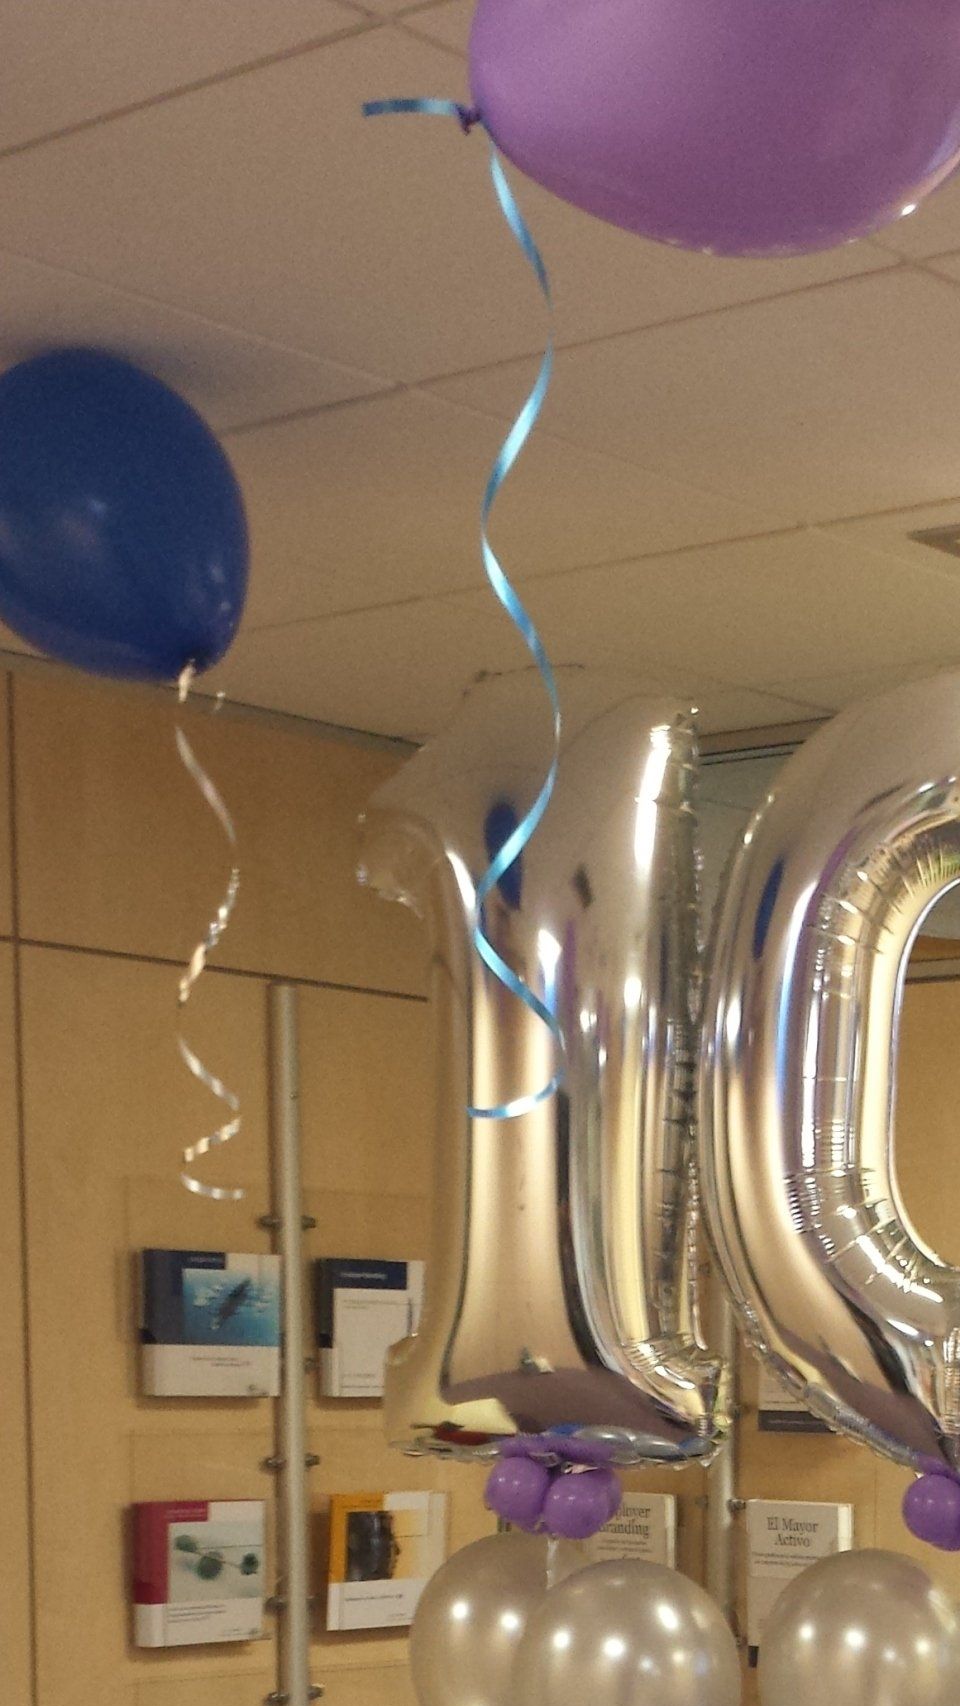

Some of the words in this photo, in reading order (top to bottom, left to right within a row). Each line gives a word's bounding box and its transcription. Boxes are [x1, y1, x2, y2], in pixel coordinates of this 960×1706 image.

[766, 1516, 778, 1531] El
[781, 1518, 819, 1536] Mayor
[774, 1533, 811, 1548] Activo
